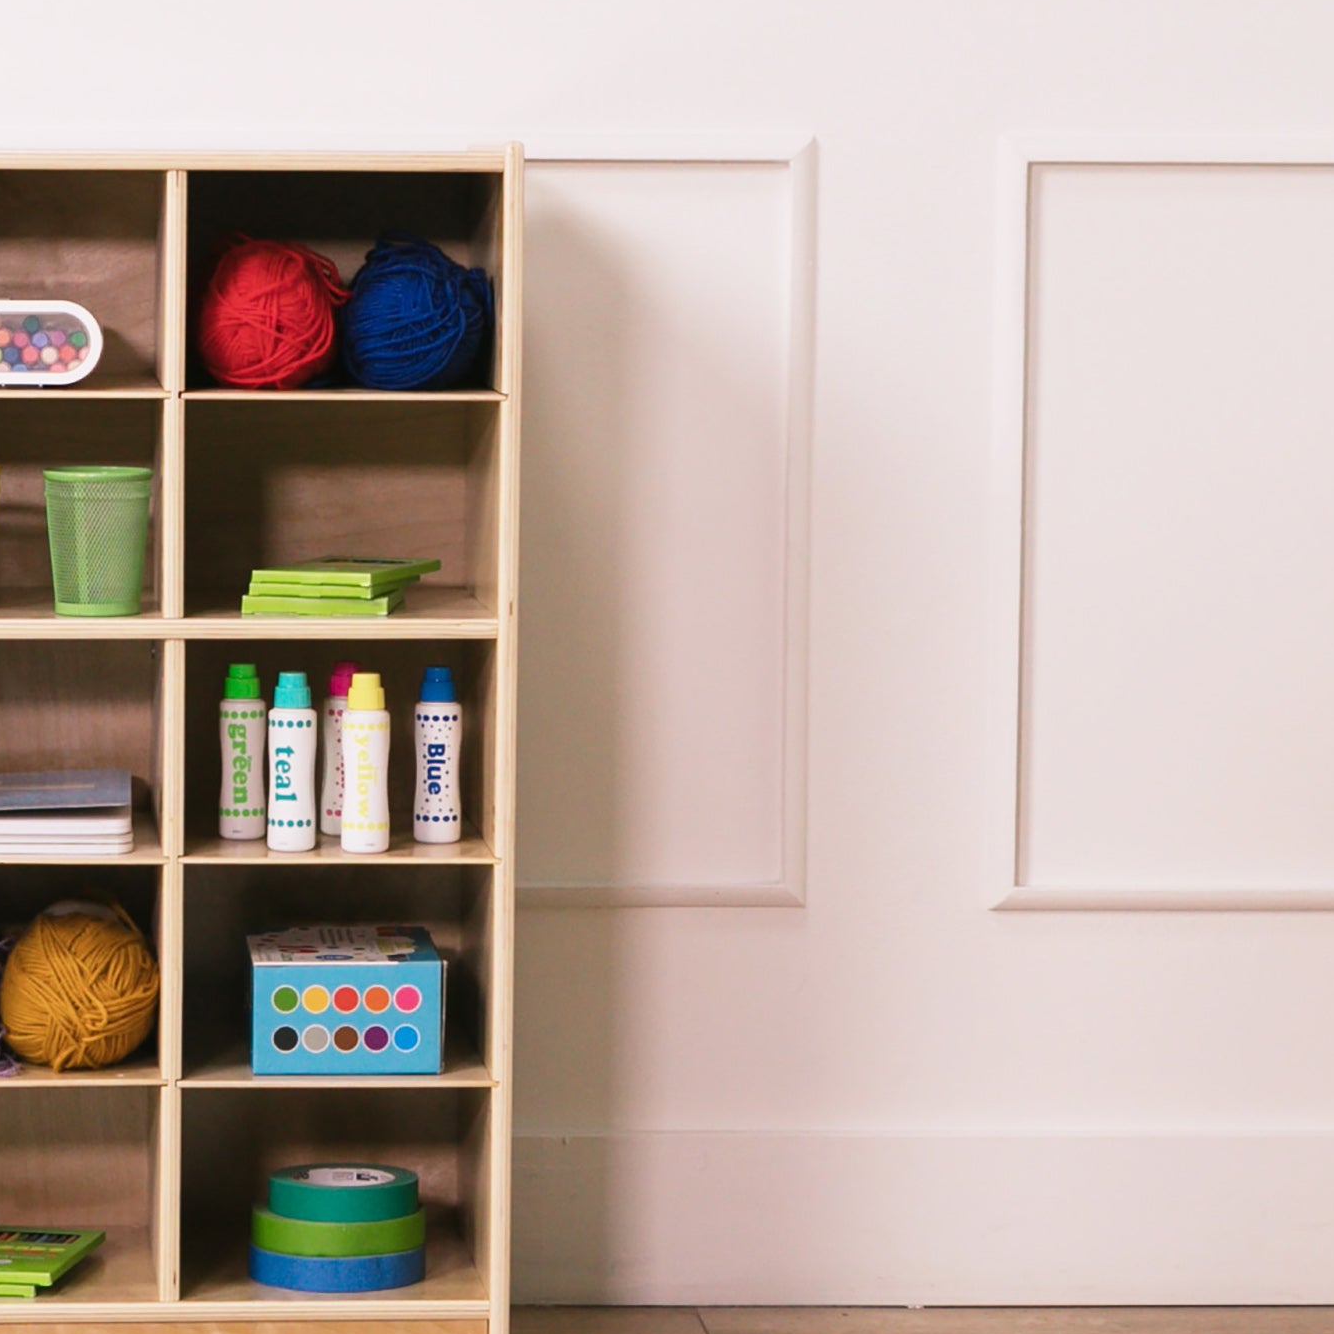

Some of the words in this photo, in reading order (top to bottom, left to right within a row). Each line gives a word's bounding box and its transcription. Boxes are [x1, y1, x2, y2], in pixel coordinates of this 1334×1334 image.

[227, 723, 249, 805] green
[275, 746, 298, 802] teal
[354, 734, 373, 817] yellow
[426, 743, 446, 796] Blue
